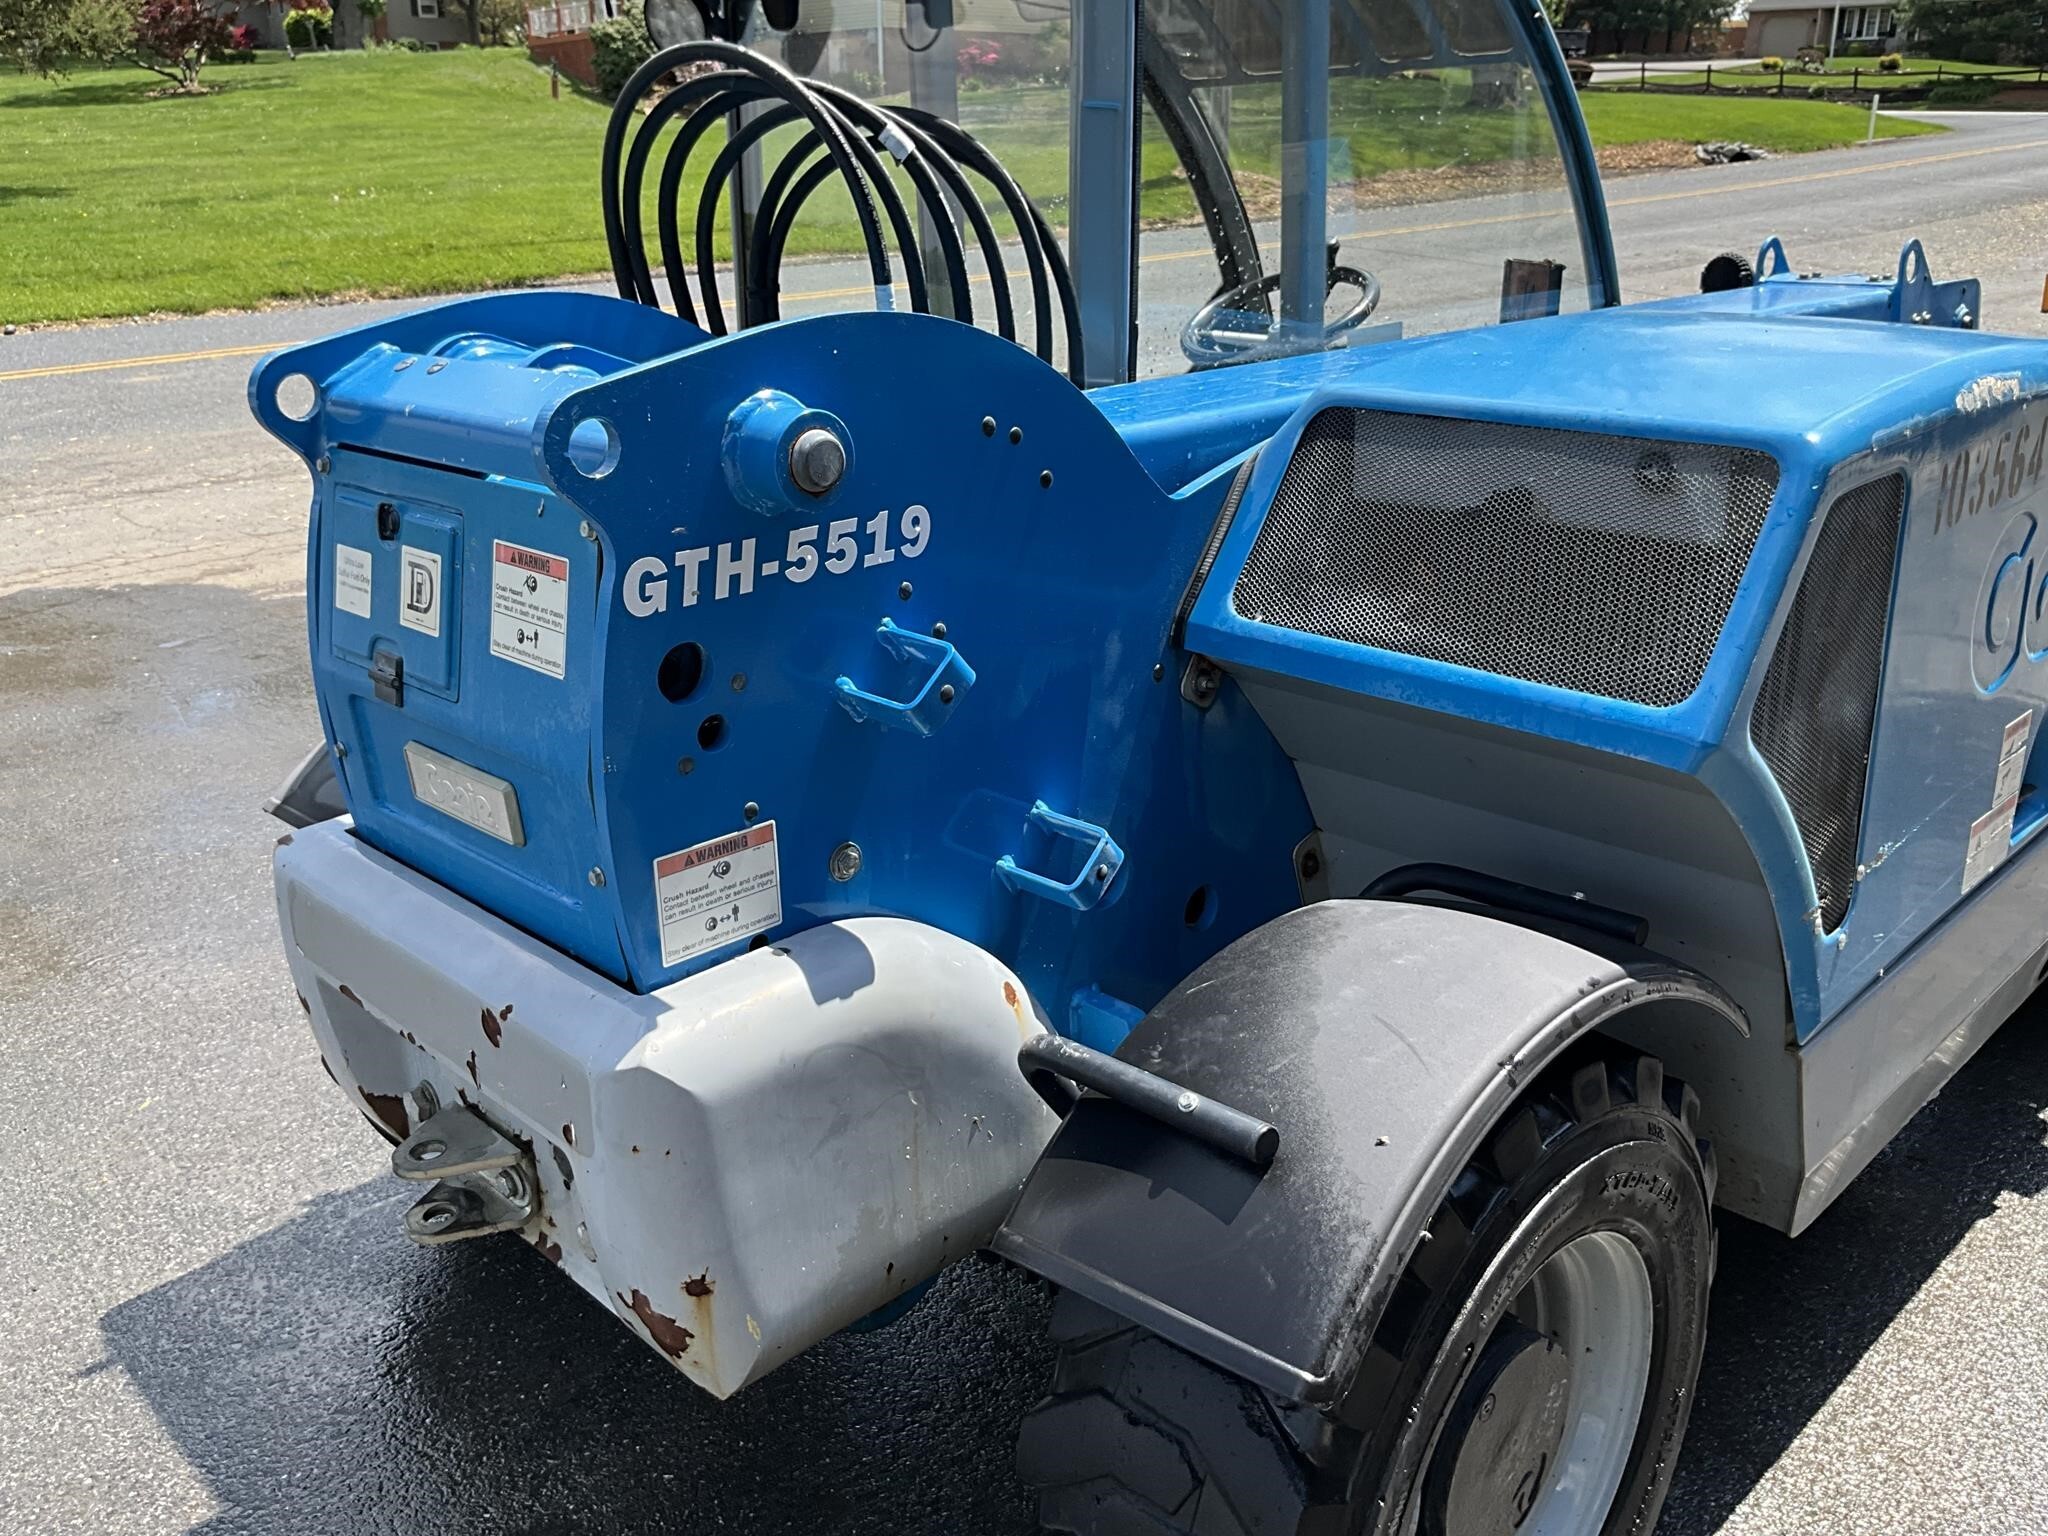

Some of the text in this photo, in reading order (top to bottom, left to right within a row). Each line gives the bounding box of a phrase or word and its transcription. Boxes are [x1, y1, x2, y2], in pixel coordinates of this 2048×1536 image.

[518, 552, 550, 572] WARNING
[622, 505, 931, 618] GTH-5519
[406, 560, 434, 615] D
[695, 836, 748, 862] WARNING
[663, 883, 709, 903] Crush Hazard
[664, 869, 774, 911] Contact between wheel and chassis
[665, 912, 676, 920] can
[679, 905, 696, 914] result
[706, 895, 723, 905] death
[733, 885, 755, 895] serious
[668, 947, 681, 957] Stay
[682, 940, 696, 951] clear
[698, 937, 704, 945] of
[704, 929, 730, 942] machine
[731, 922, 749, 933] during
